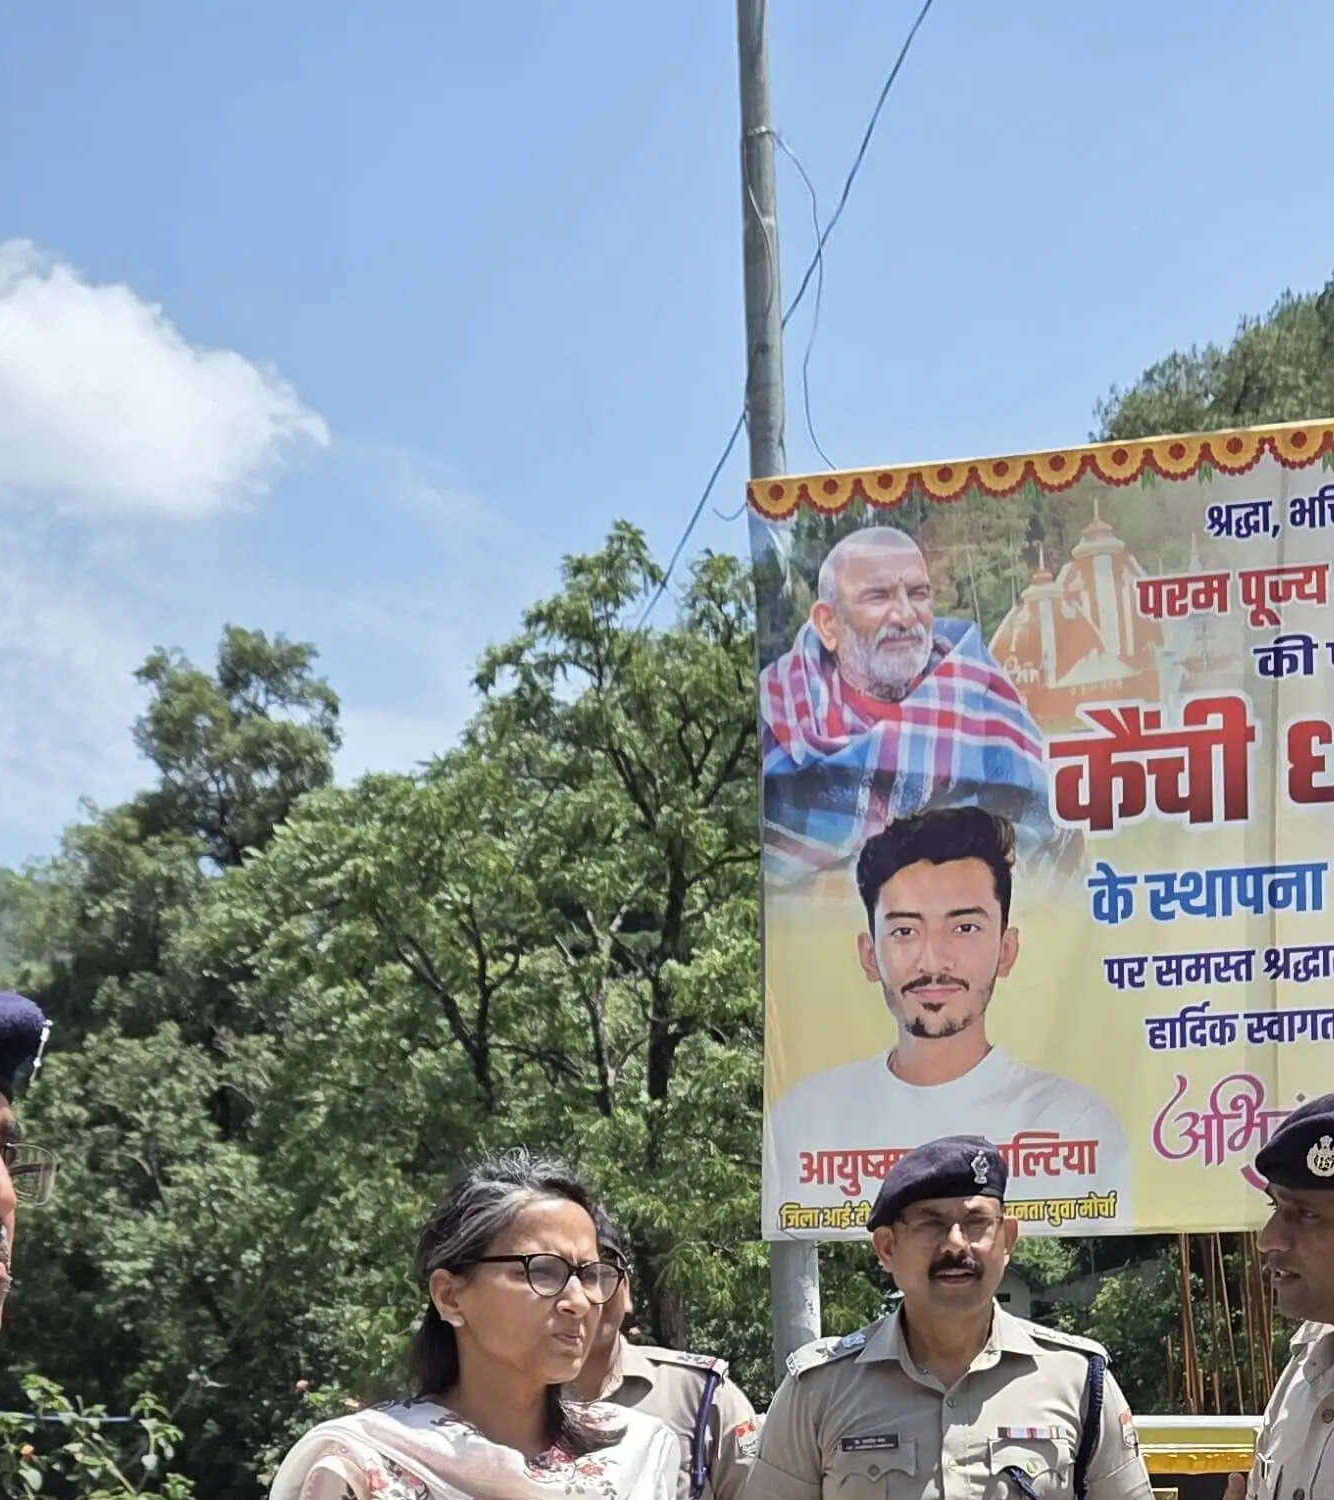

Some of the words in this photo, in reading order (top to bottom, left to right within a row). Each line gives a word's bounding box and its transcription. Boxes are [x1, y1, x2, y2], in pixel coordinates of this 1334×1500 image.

[1206, 498, 1280, 540] श्रद्धा,
[1136, 574, 1230, 619] परम
[1239, 561, 1330, 628] पूज्य
[1254, 632, 1315, 678] की
[1049, 696, 1255, 831] कैंची
[1087, 861, 1137, 925] के
[1144, 861, 1328, 922] स्थापना
[1103, 954, 1153, 990] पर
[1153, 949, 1255, 987] समस्त
[1145, 1000, 1238, 1050] हार्दिक
[779, 1202, 820, 1230] जिला
